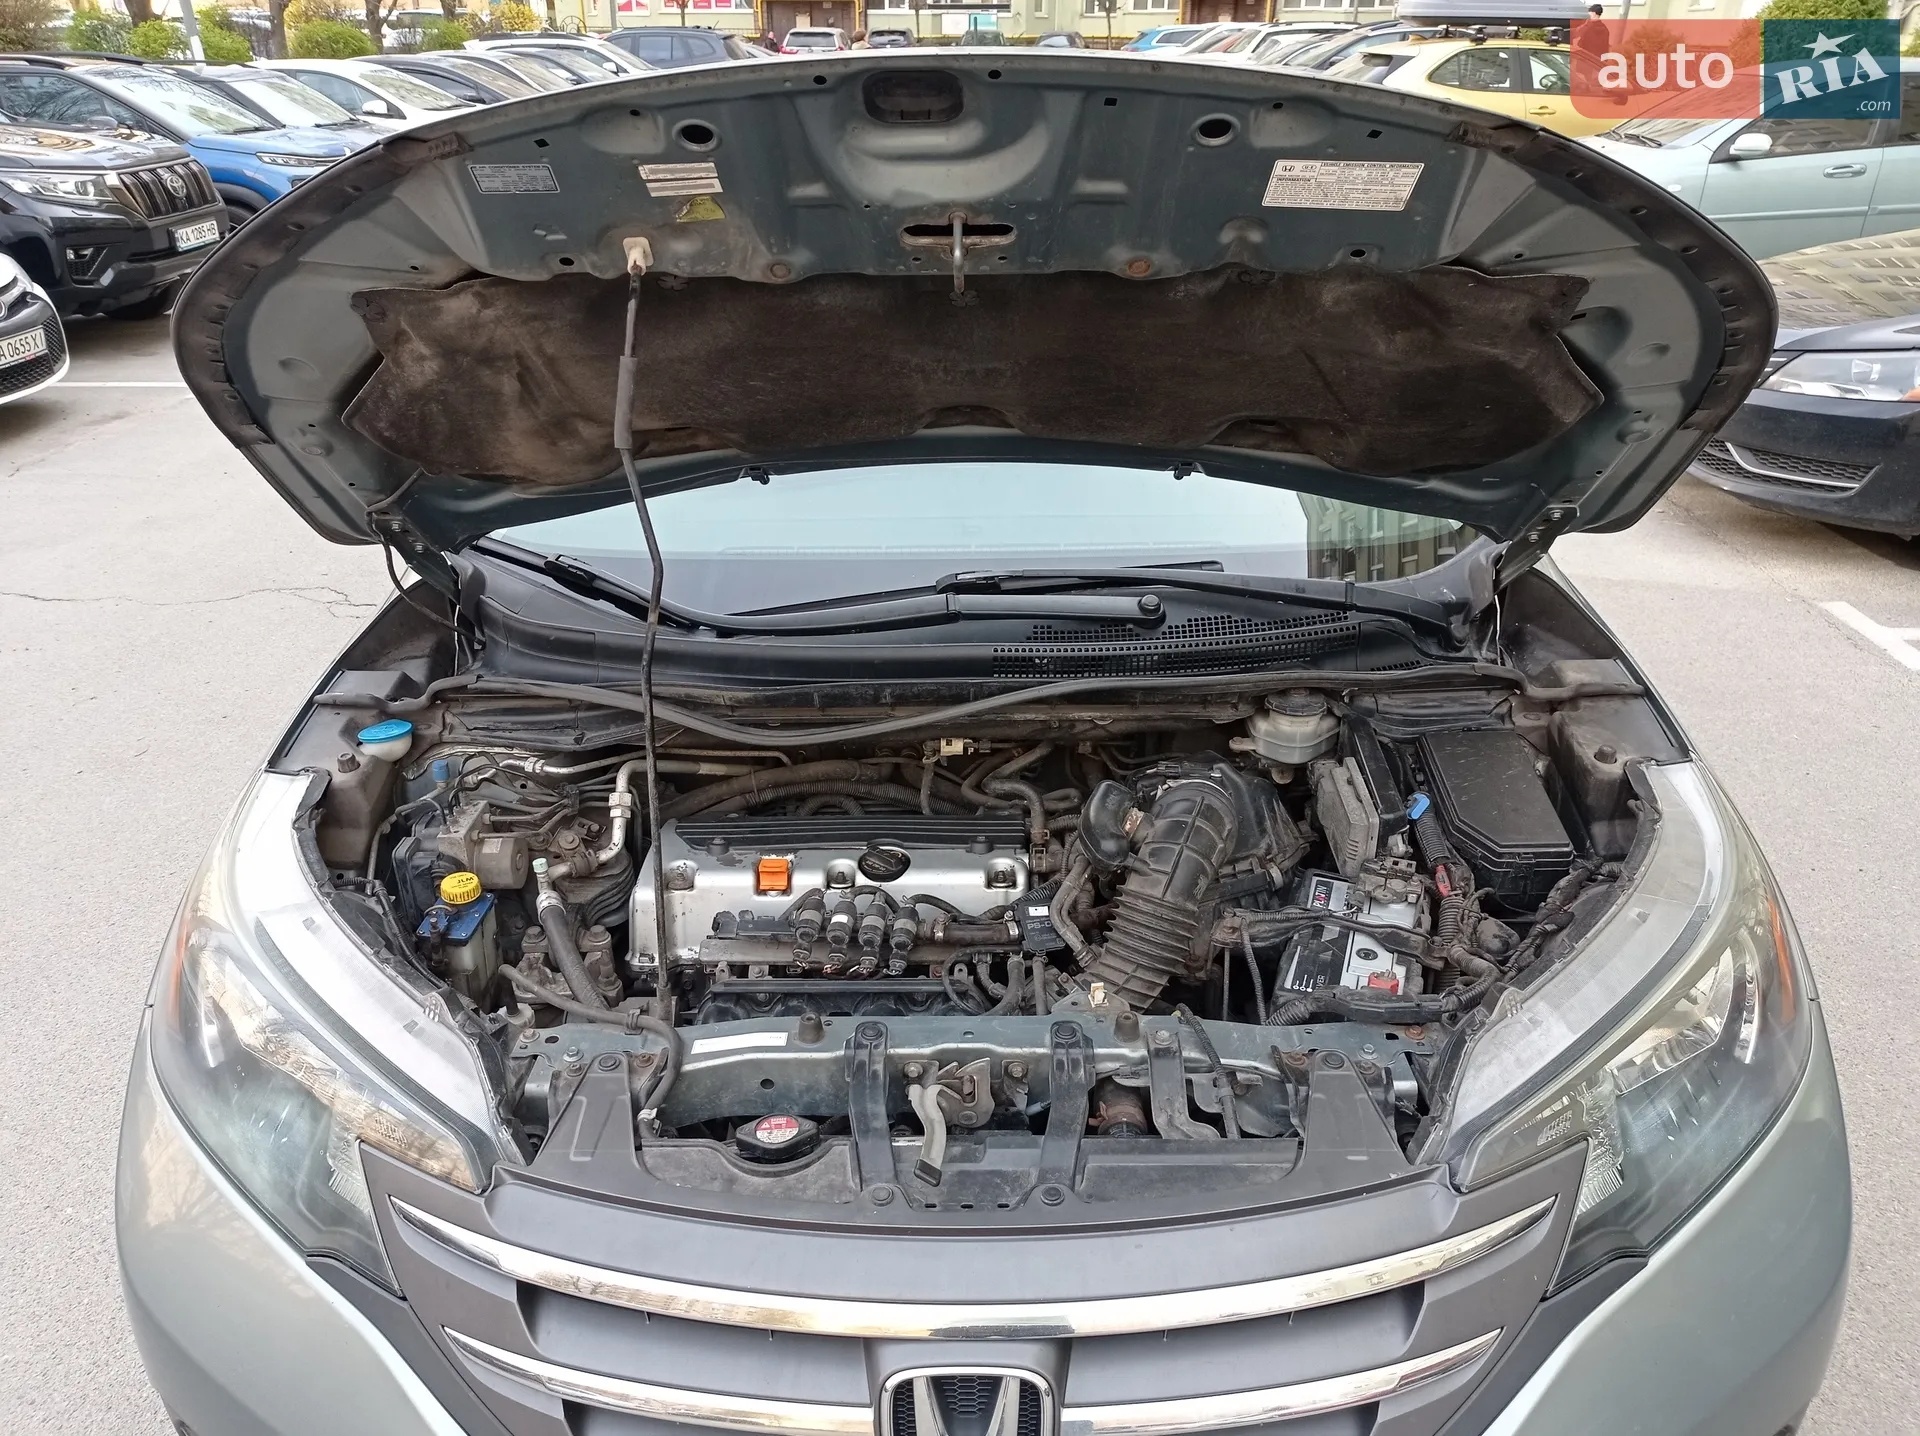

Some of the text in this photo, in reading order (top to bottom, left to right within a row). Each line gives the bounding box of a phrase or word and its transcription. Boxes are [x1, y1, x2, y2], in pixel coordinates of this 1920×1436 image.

[179, 222, 216, 244] KA 1285 HB
[7, 336, 31, 358] 0655
